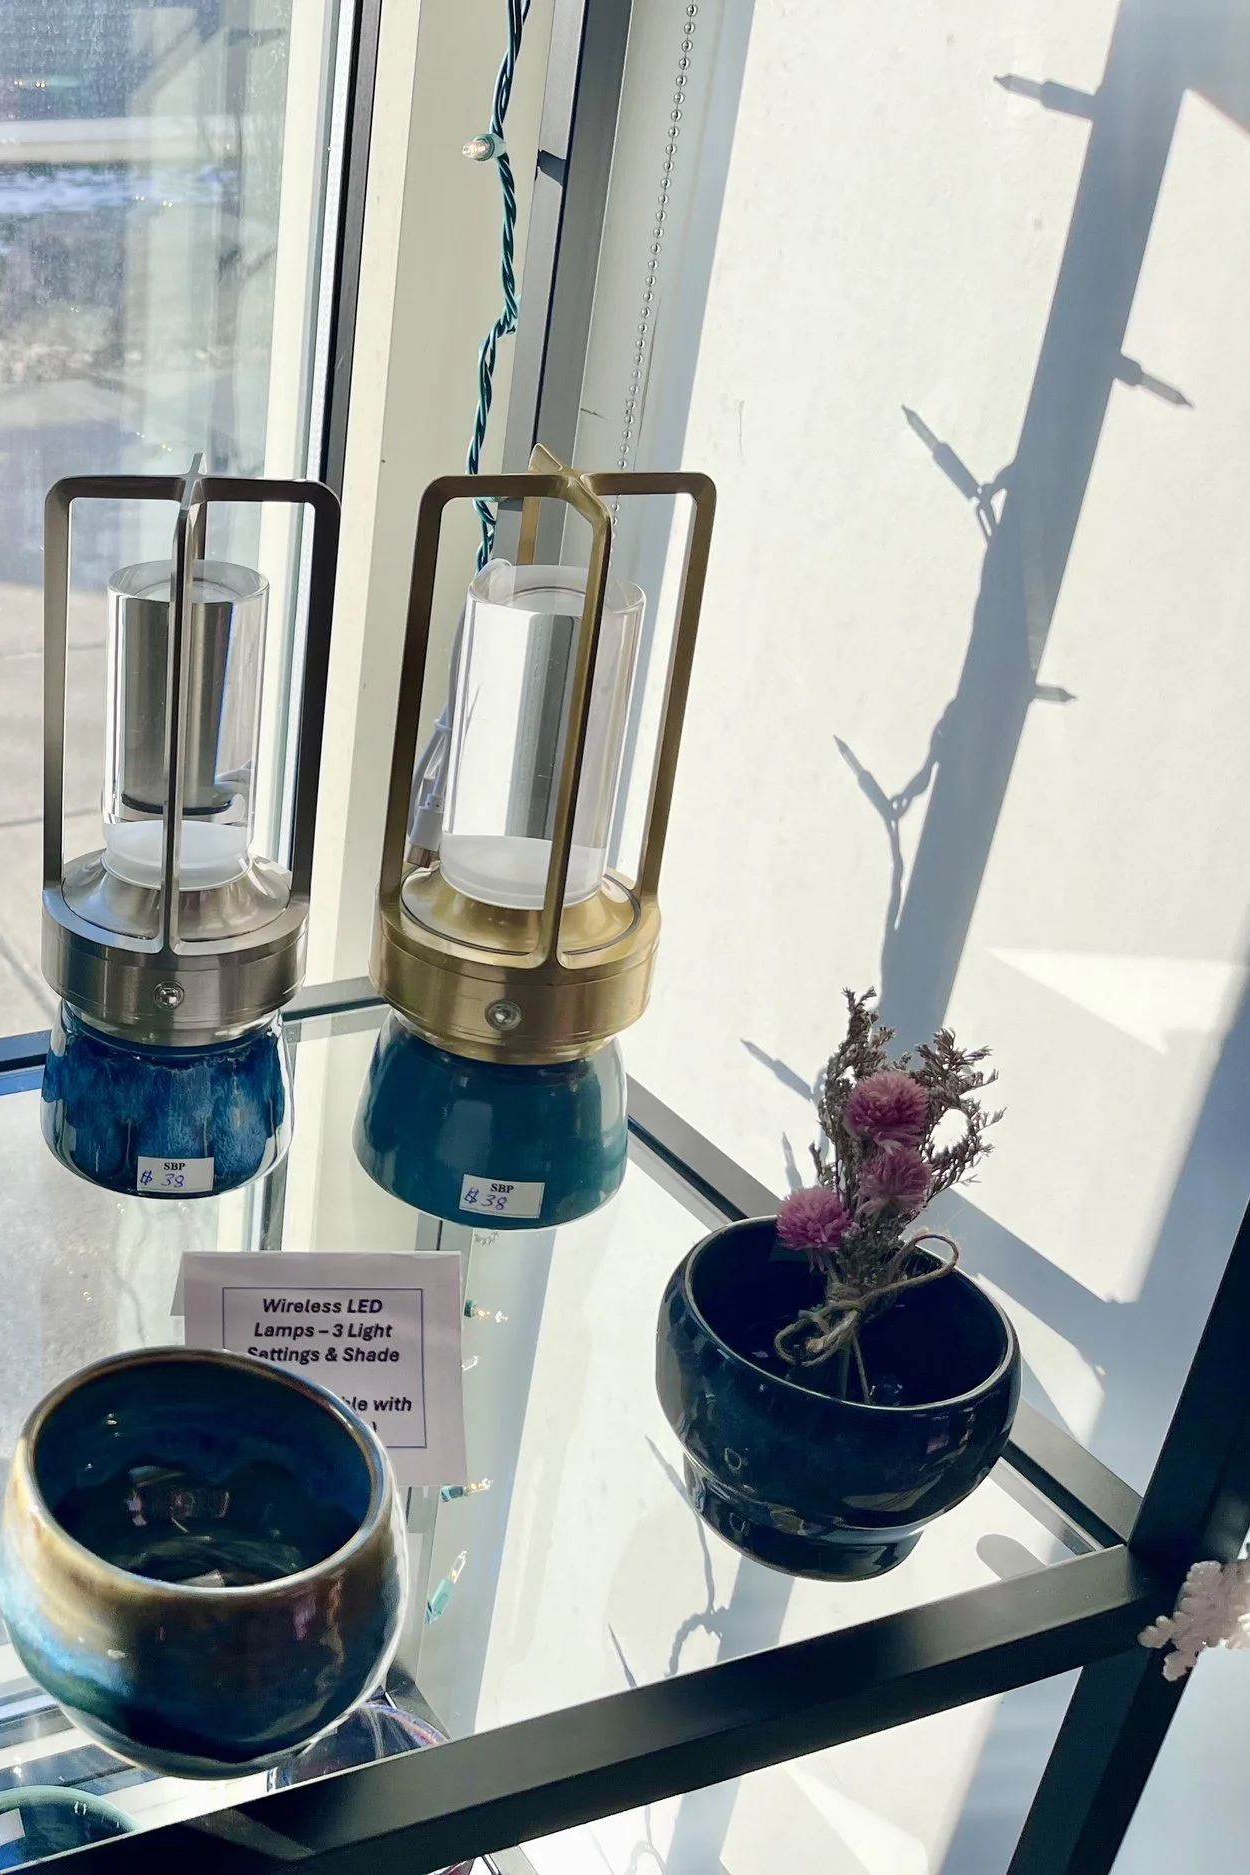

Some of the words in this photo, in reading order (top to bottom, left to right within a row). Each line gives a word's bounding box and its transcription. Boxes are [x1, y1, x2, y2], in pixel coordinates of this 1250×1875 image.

[164, 1162, 186, 1171] SBP
[490, 1183, 515, 1193] SBP
[262, 1298, 342, 1314] Wireless
[347, 1299, 383, 1314] LED
[253, 1322, 315, 1341] Lamps
[332, 1323, 343, 1338] 3
[347, 1323, 393, 1341] Light
[325, 1347, 338, 1362] &
[342, 1347, 400, 1362] Shade
[373, 1396, 412, 1411] with
